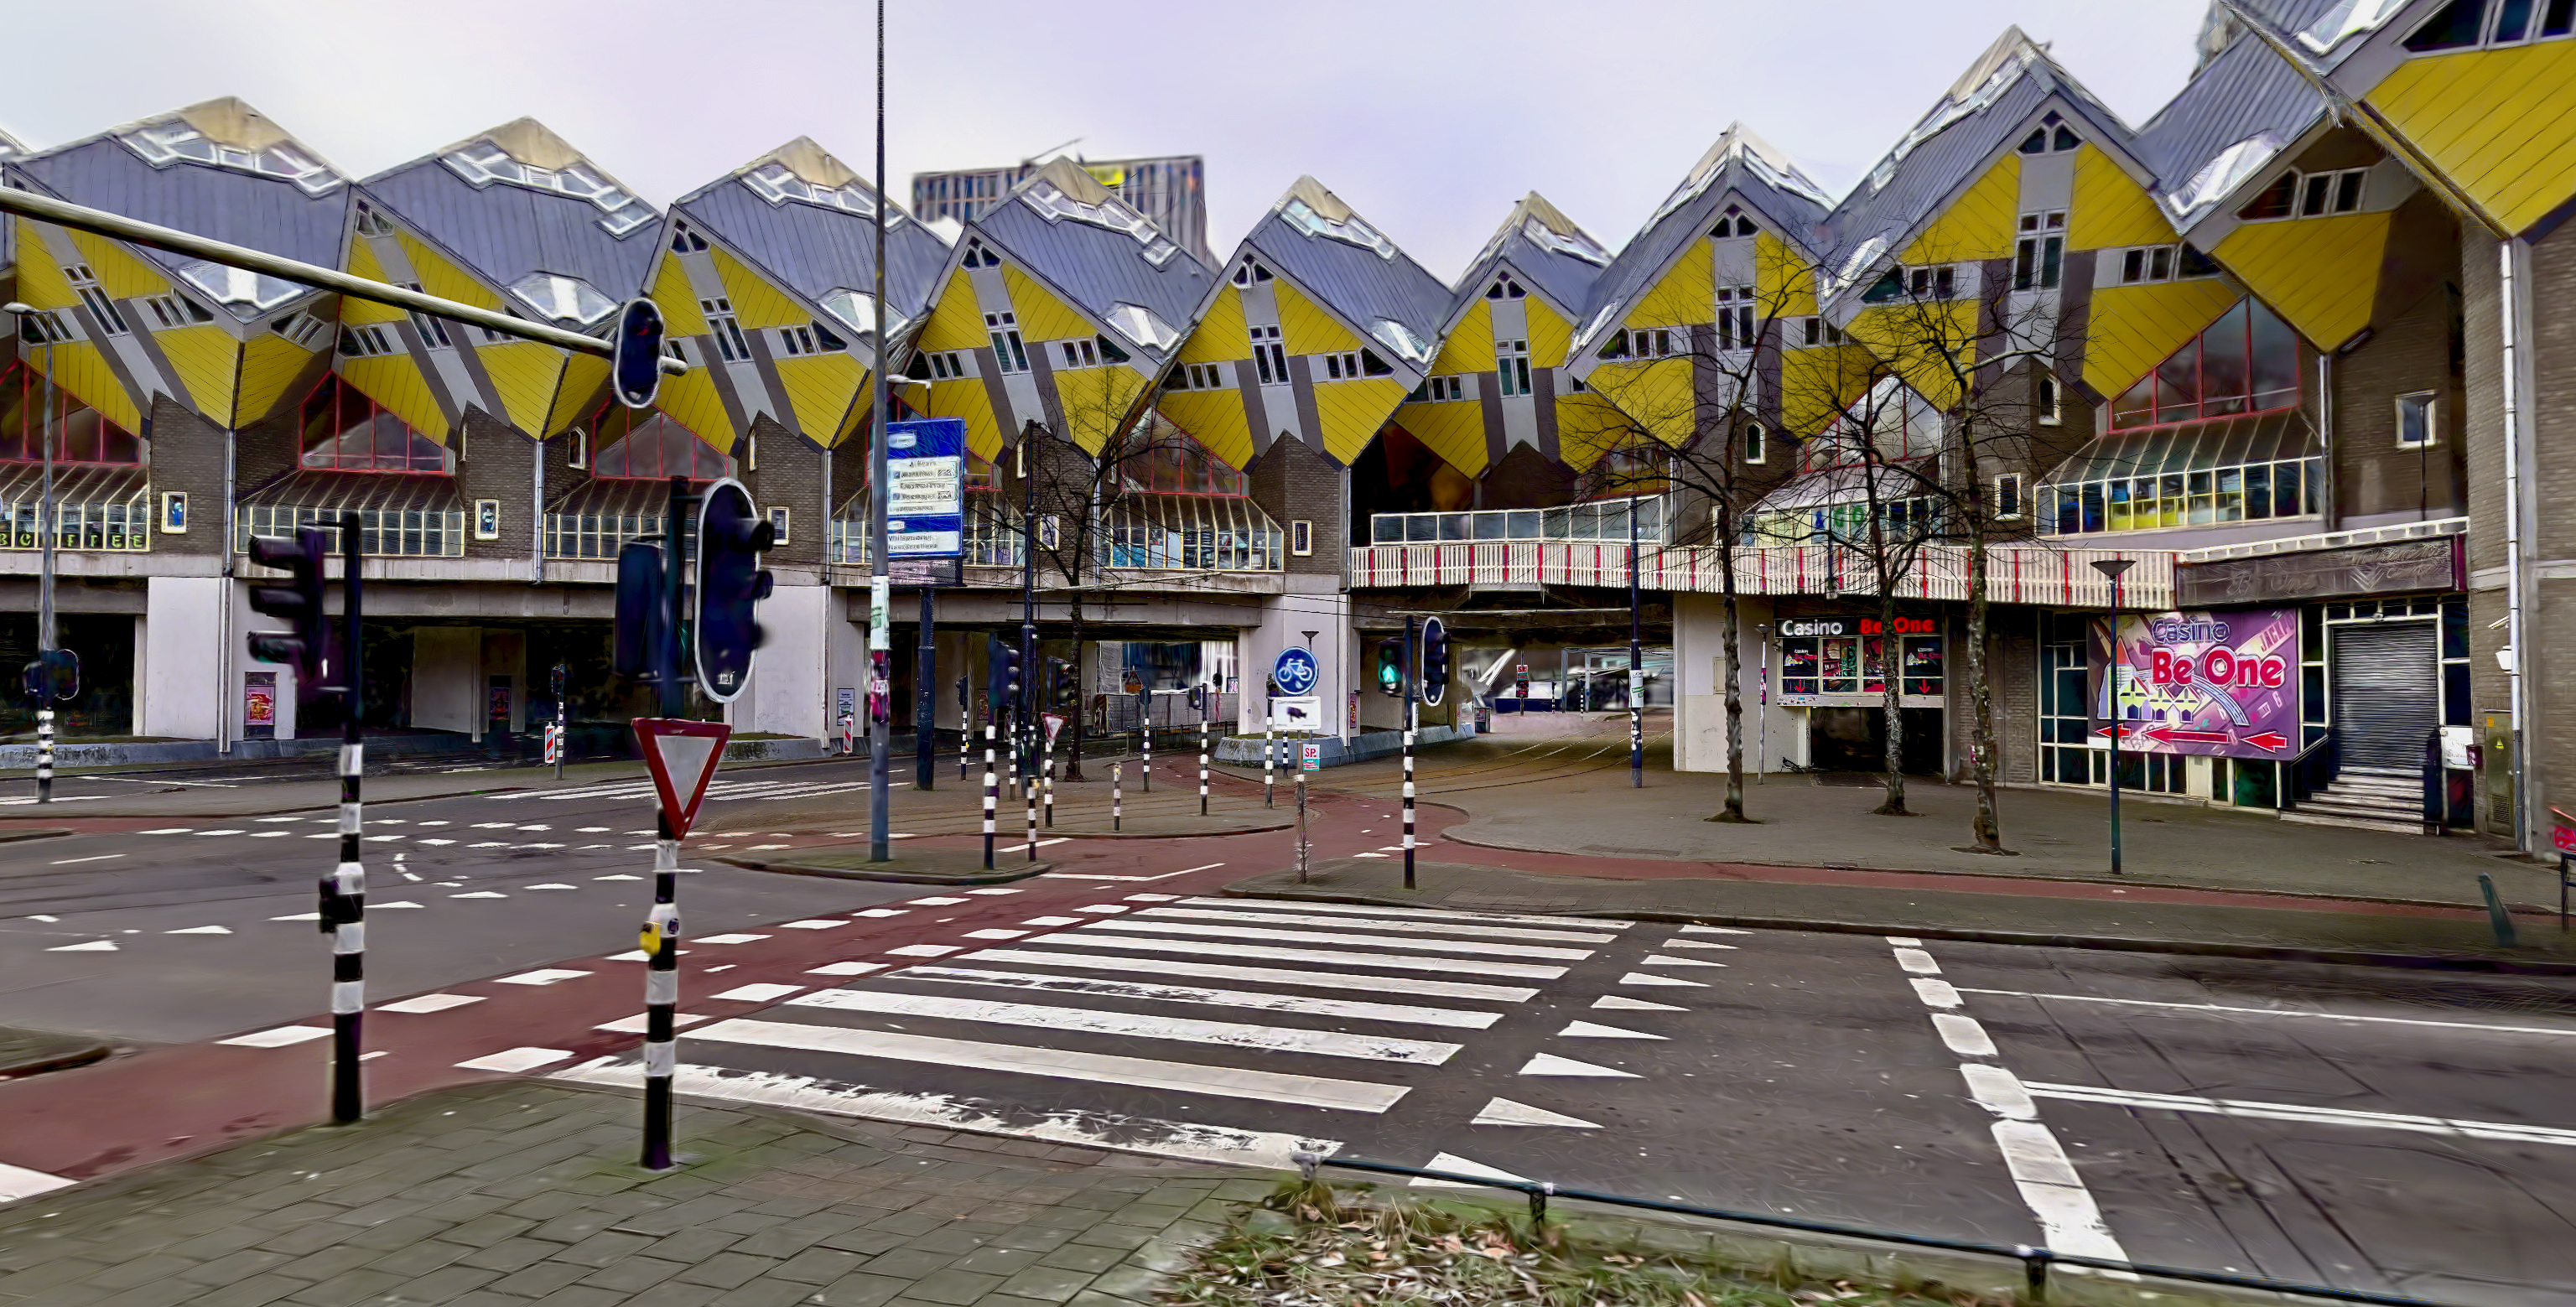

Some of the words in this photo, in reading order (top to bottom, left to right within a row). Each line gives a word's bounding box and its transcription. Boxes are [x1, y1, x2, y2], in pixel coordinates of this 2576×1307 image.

[1835, 506, 1864, 527] GO
[19, 533, 143, 547] CFFEE
[1782, 620, 1842, 635] Casino
[1861, 619, 1882, 634] Be
[1893, 616, 1935, 633] One
[2153, 617, 2230, 643] Casino
[2152, 648, 2196, 685] Be
[2204, 646, 2285, 687] One
